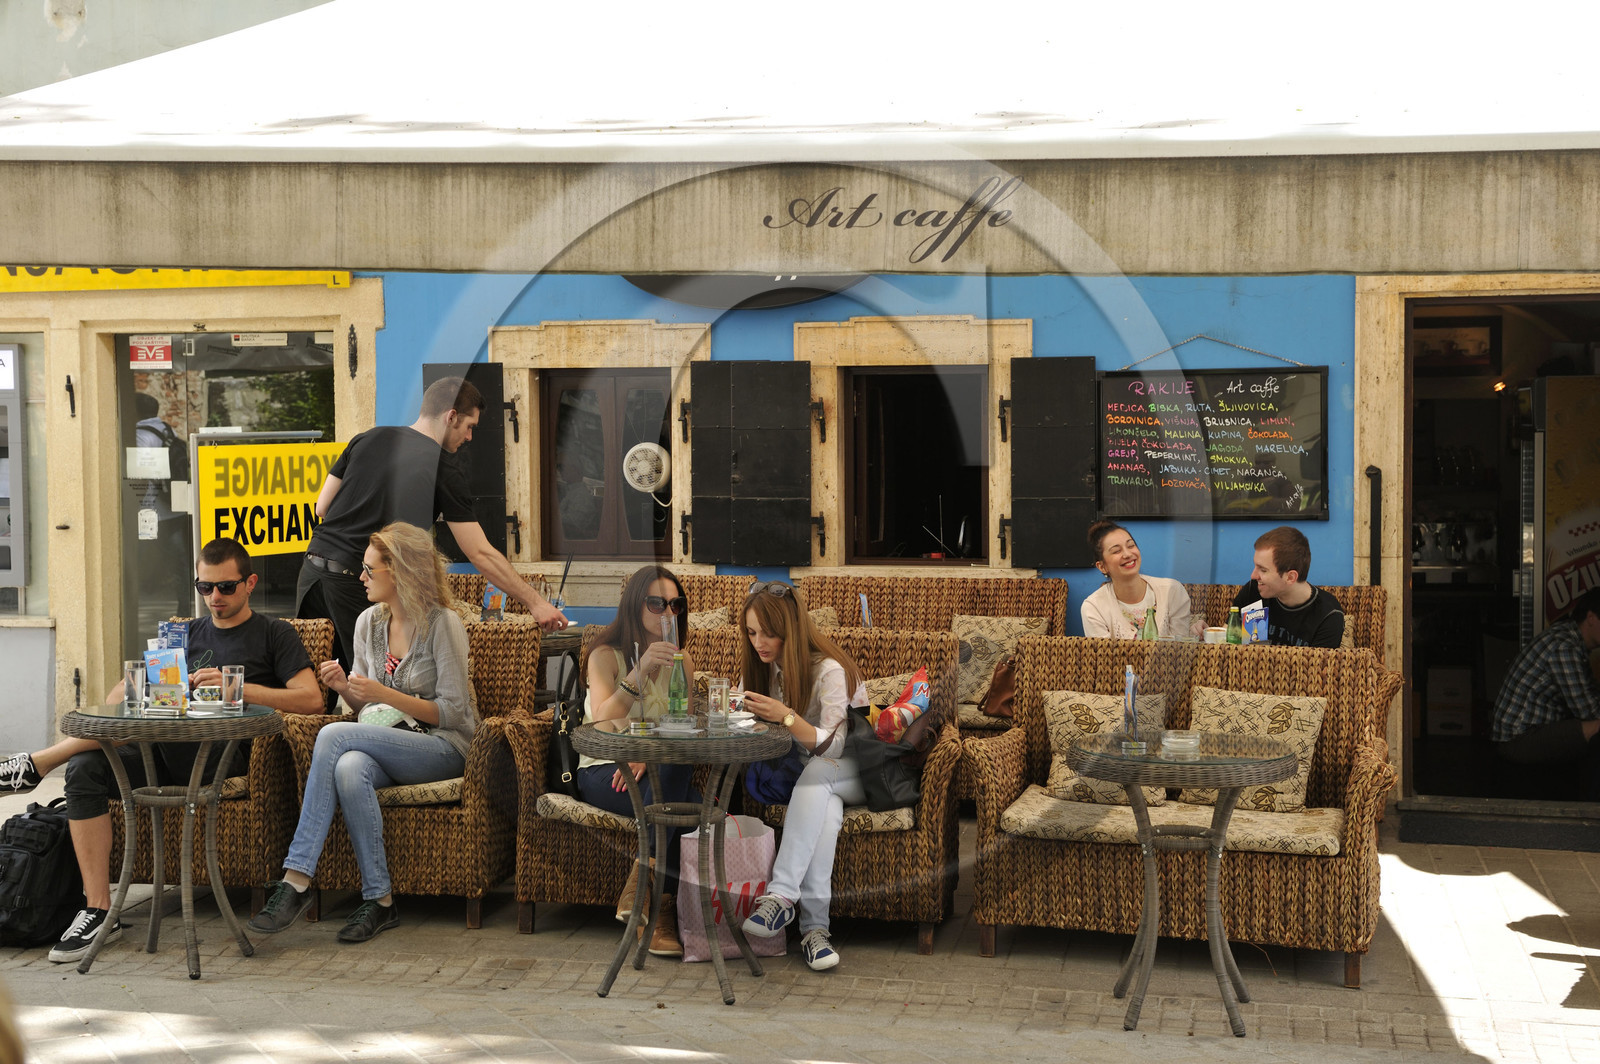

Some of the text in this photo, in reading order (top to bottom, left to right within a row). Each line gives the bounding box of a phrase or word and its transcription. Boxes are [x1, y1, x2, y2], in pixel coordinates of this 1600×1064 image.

[763, 175, 1025, 264] Art caffe
[1128, 381, 1195, 396] RAKIJE
[1226, 376, 1280, 398] Art caffe
[1106, 413, 1164, 426] BOROVNICA,
[1203, 416, 1256, 427] BRUSNICA,
[1164, 429, 1204, 442] MALINA,
[1208, 430, 1245, 442] KUPINA,
[1107, 449, 1139, 461] GREJP,
[1255, 444, 1309, 456] MARELICA,
[214, 502, 322, 546] EXCHAN
